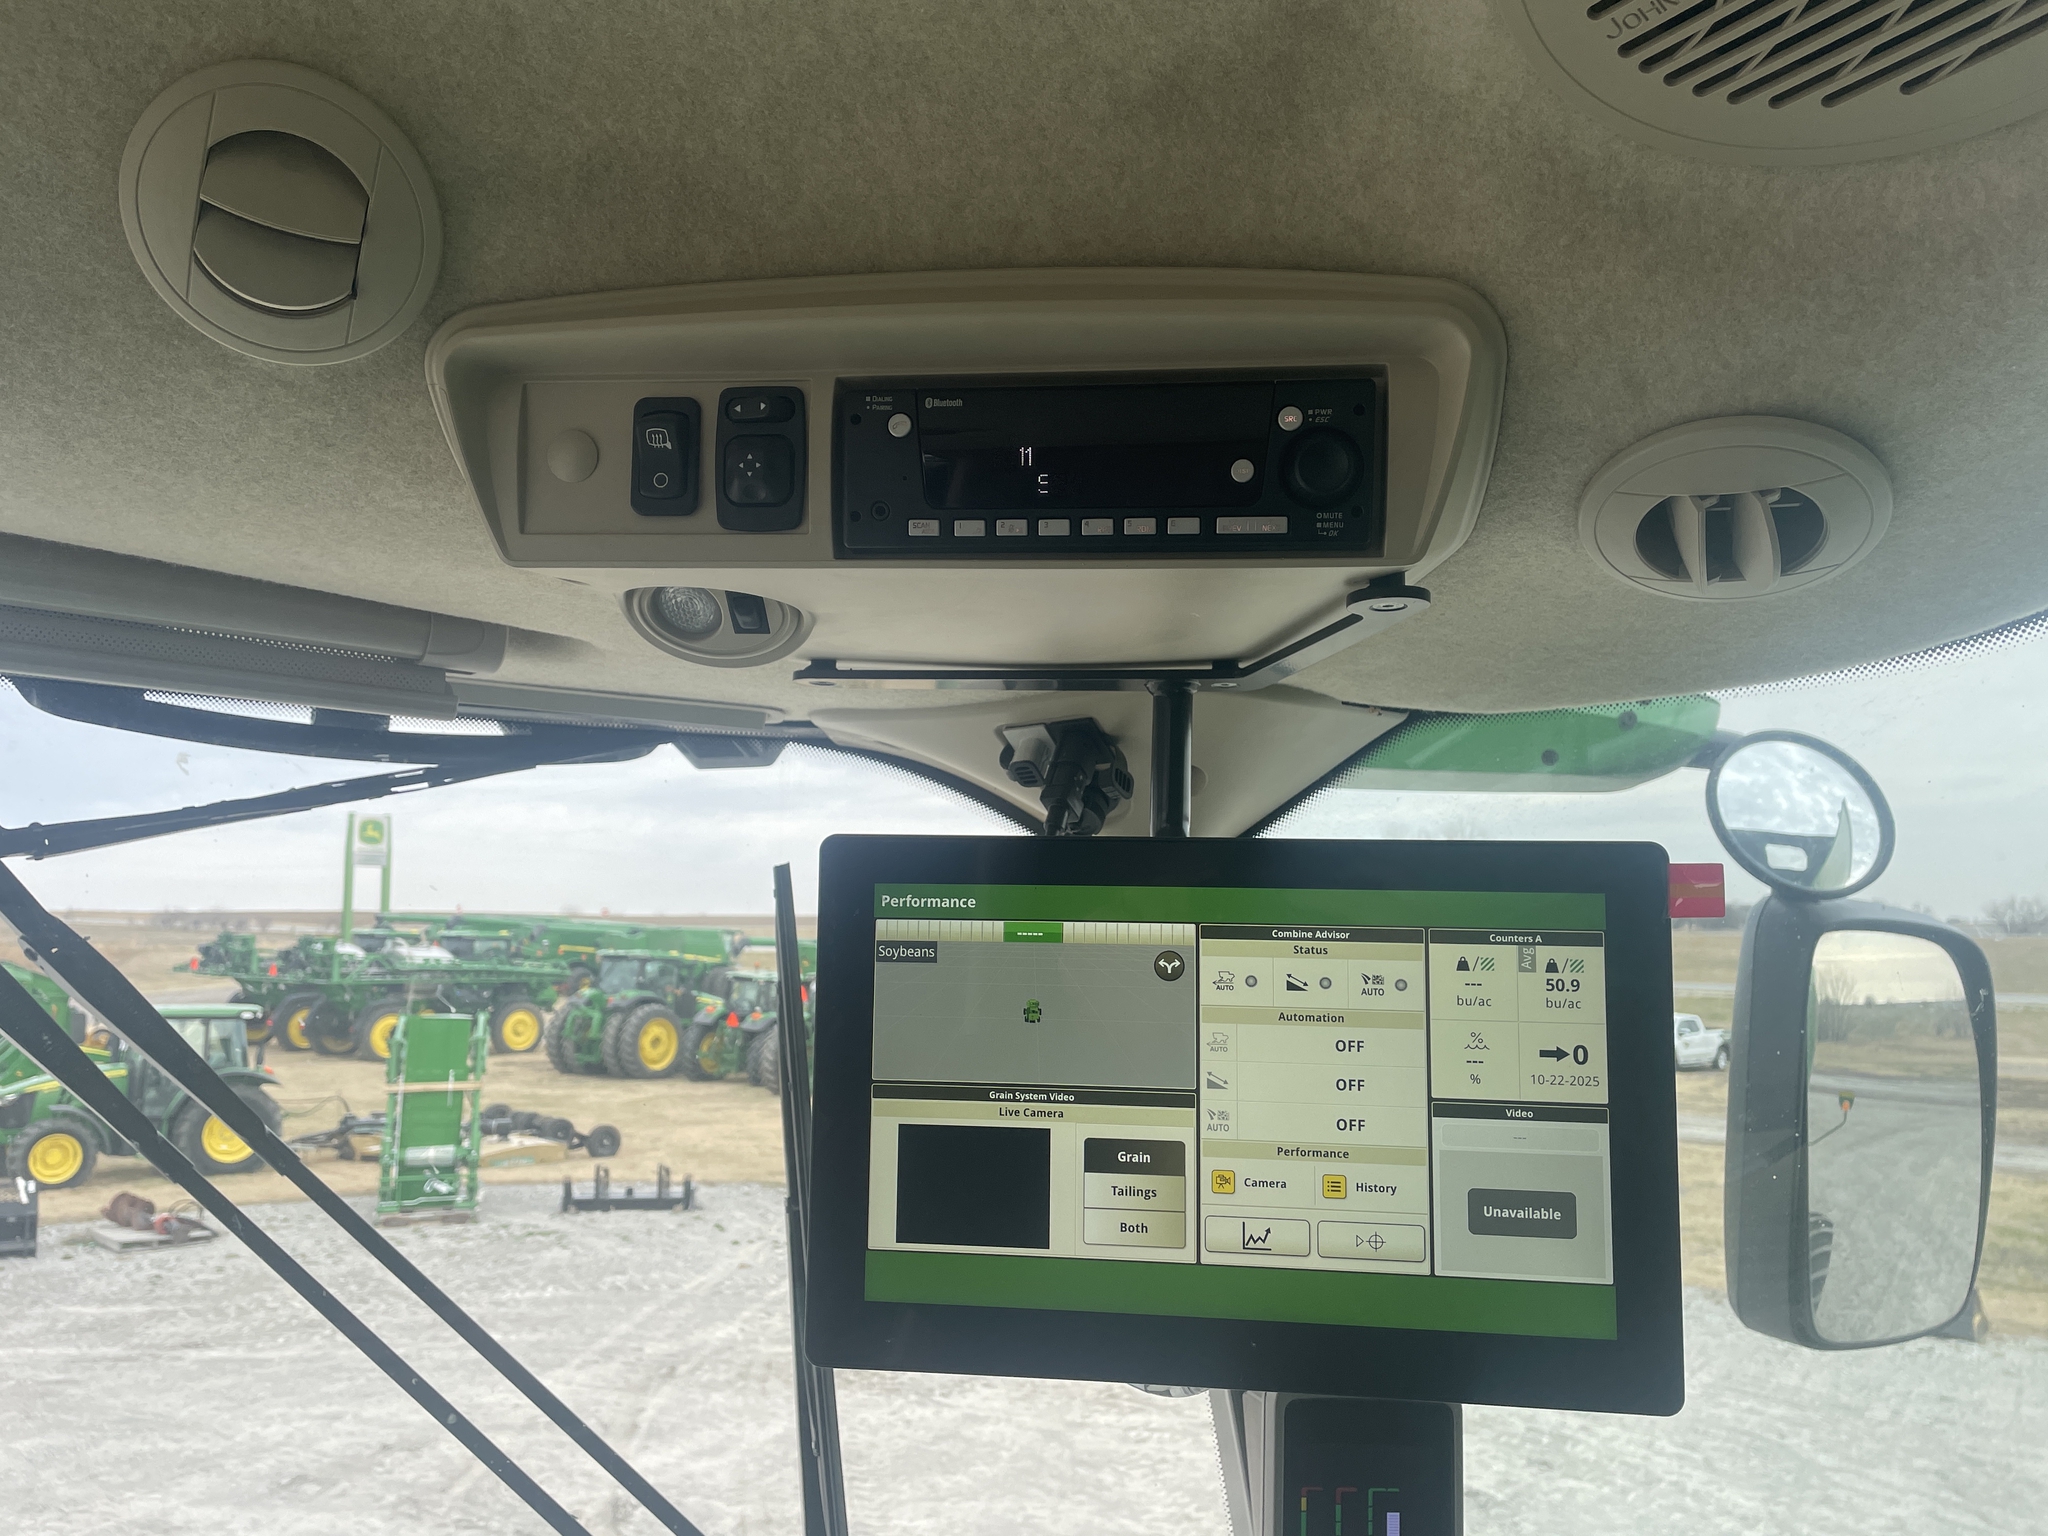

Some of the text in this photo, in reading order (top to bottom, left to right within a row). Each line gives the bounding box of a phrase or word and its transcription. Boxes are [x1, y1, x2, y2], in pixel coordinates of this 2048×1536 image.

[933, 398, 963, 407] Bluetooth
[881, 894, 977, 908] Performance
[1271, 929, 1351, 939] Combine Advisor
[1489, 933, 1543, 943] Counters A
[878, 944, 936, 959] Soybeans
[1292, 945, 1329, 955] Status
[1520, 947, 1534, 970] Avg
[1545, 978, 1581, 992] 50.9
[1360, 987, 1385, 996] AUTO
[1456, 995, 1492, 1007] bu/ac
[1545, 997, 1582, 1009] bu/ac
[1278, 1012, 1345, 1023] Automation
[1335, 1040, 1365, 1052] OFF
[1572, 1044, 1589, 1066] 0
[1335, 1079, 1365, 1091] OFF
[1530, 1074, 1600, 1087] 10-22-2025
[989, 1091, 1075, 1102] Grain System Video
[998, 1107, 1064, 1118] Live Camera
[1505, 1109, 1534, 1118] Video
[1206, 1124, 1230, 1132] AUTO
[1336, 1119, 1366, 1131] OFF
[1117, 1151, 1151, 1163] Grain
[1276, 1146, 1350, 1159] Performance
[1244, 1177, 1287, 1189] Camera
[1355, 1181, 1398, 1196] History
[1111, 1185, 1157, 1200] Tailings
[1482, 1205, 1562, 1221] Unavailable
[1119, 1221, 1148, 1234] Both
